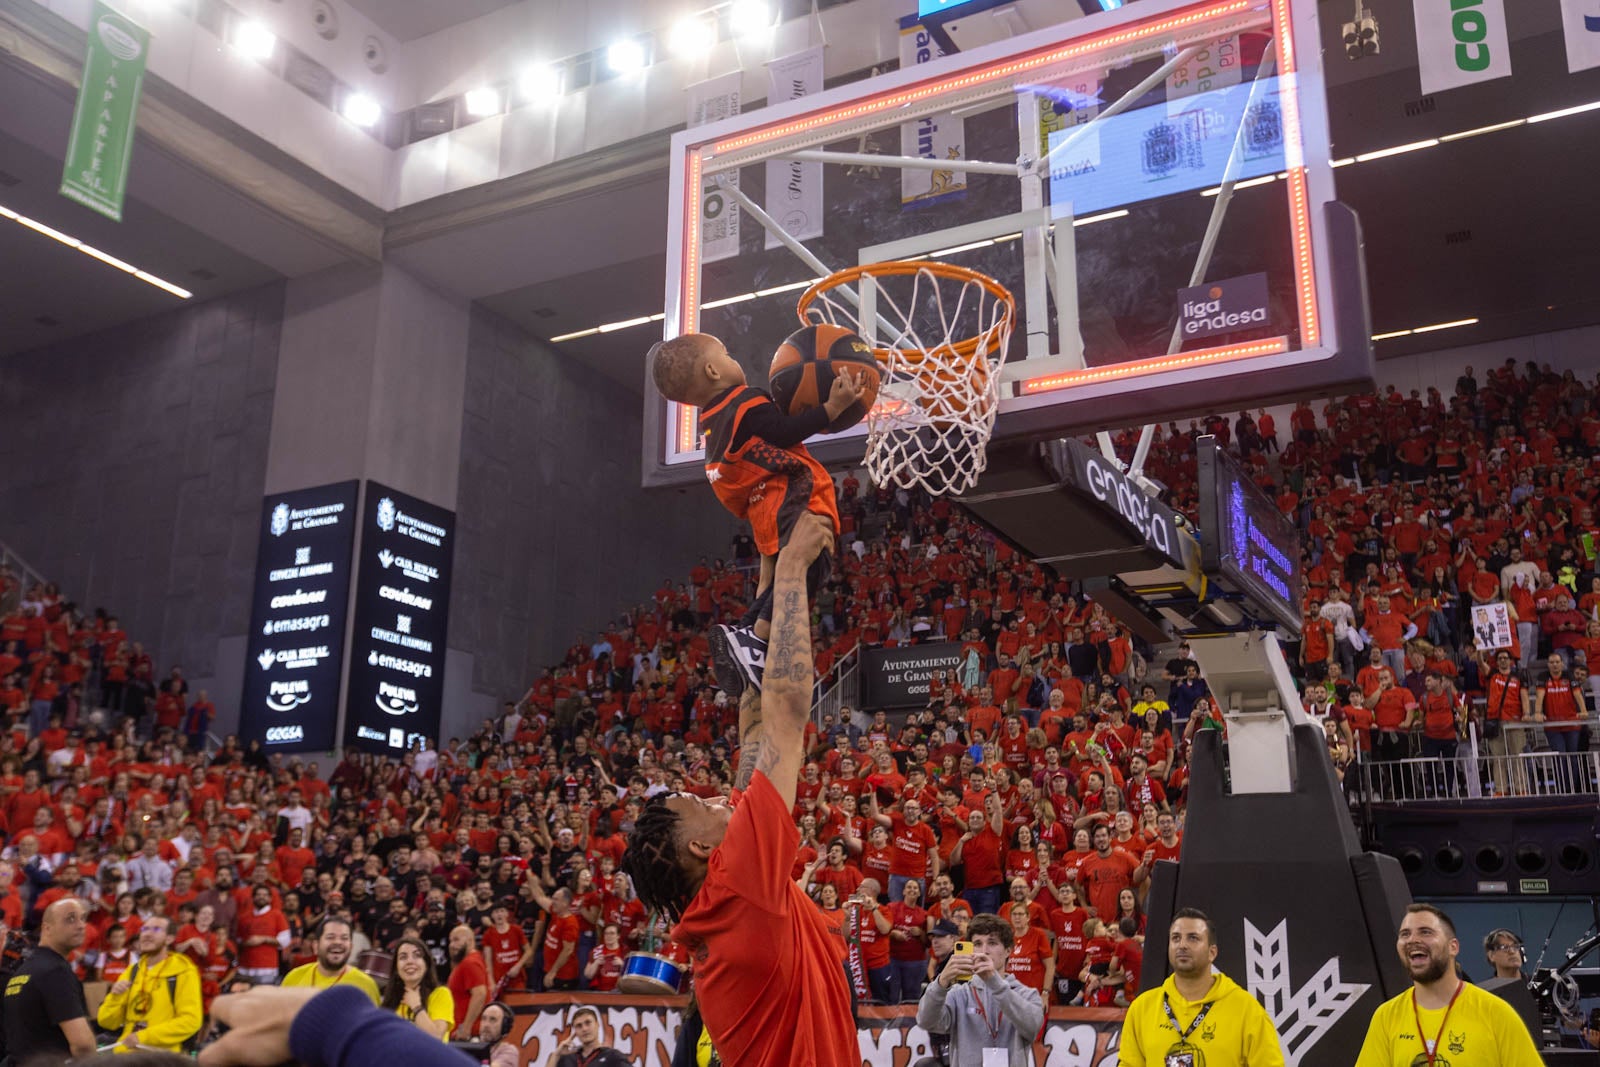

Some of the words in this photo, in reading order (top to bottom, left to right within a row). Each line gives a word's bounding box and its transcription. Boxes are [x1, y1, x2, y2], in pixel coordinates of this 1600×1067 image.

[1183, 300, 1220, 318] liga
[1185, 307, 1267, 333] endesa
[289, 503, 345, 520] AYUNTAMIENTO
[292, 520, 303, 531] DE
[303, 514, 339, 529] GRANADA
[395, 511, 447, 538] AYUNTAMIENTO
[398, 525, 409, 535] DE
[409, 526, 442, 547] GRANADA
[1247, 515, 1293, 576] AYUNTAMIENTO
[269, 567, 299, 582] CERVEZAS
[1261, 558, 1291, 602] GRANADA
[273, 614, 330, 634] emasagra
[371, 626, 401, 645] CERVEZAS
[378, 653, 432, 678] emasagra
[881, 656, 960, 672] AYUNTAMIENTO
[887, 675, 902, 684] DE
[903, 669, 947, 683] GRAND
[269, 680, 309, 696] PULEVA
[379, 681, 417, 703] PULEVA
[1522, 881, 1547, 889] SALIDA
